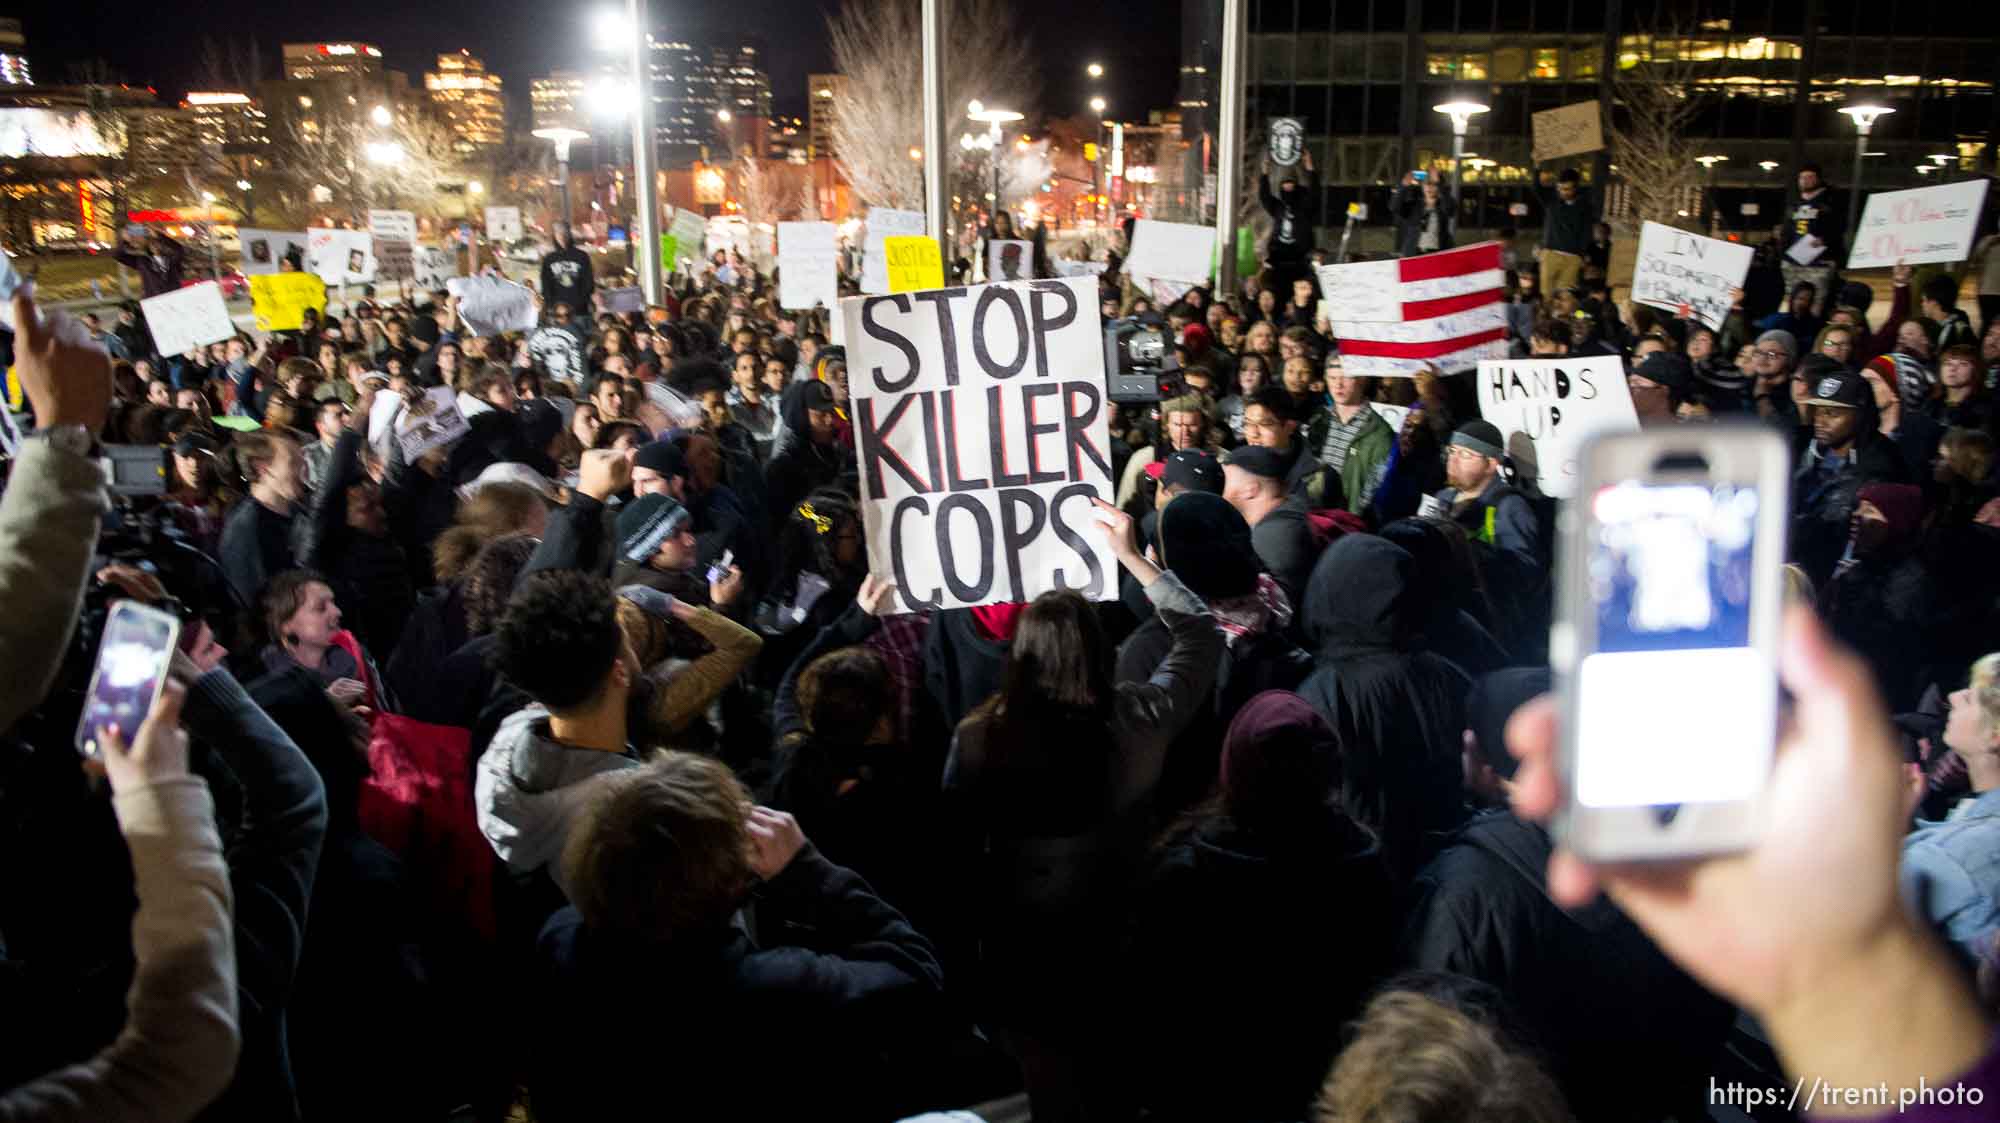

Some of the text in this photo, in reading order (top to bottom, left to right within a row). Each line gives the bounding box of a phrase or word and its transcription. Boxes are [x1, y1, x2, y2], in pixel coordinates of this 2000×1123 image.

[862, 281, 1077, 393] STOP
[1490, 367, 1598, 404] HANDS
[857, 381, 1112, 500] KILLER
[1521, 404, 1562, 442] UP
[890, 484, 1105, 612] COPS
